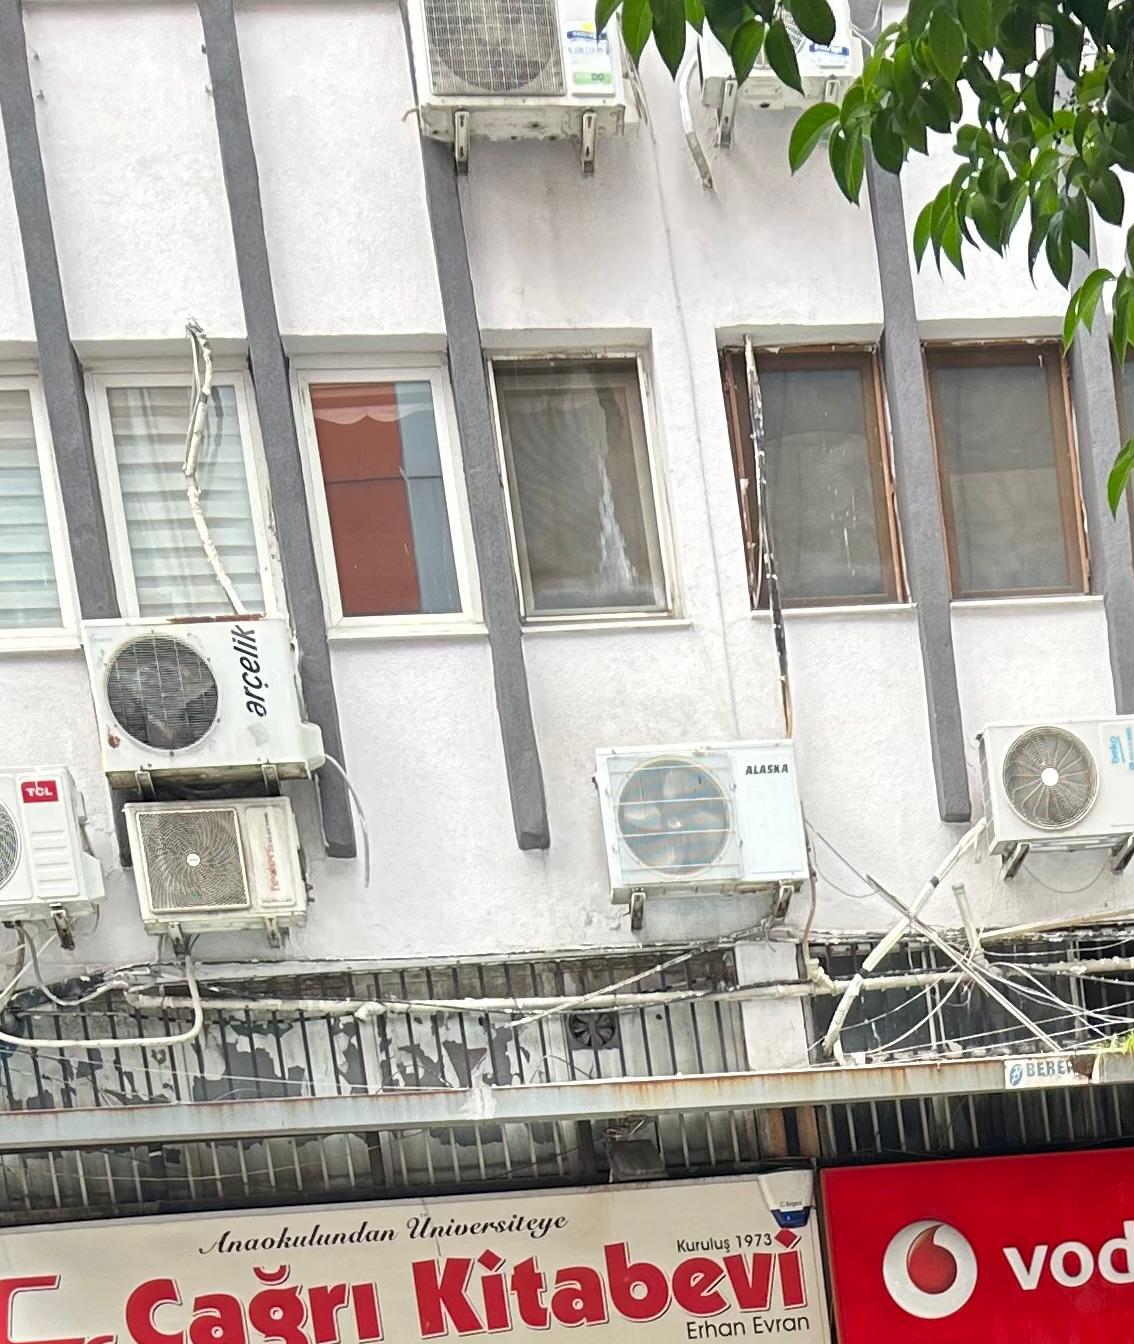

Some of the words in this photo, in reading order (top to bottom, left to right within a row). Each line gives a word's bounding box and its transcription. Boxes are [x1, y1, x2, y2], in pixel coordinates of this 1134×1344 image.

[231, 625, 268, 717] arçelik
[745, 763, 789, 775] ALASKA
[26, 785, 54, 797] TCL
[198, 1221, 399, 1254] Anaokulundan
[406, 1212, 570, 1240] Üniversiteye
[676, 1236, 731, 1253] Kuruluş
[735, 1233, 773, 1249] 1973
[411, 1228, 807, 1339] Kitabevi
[686, 1320, 746, 1340] Erhan
[753, 1315, 810, 1334] Evran
